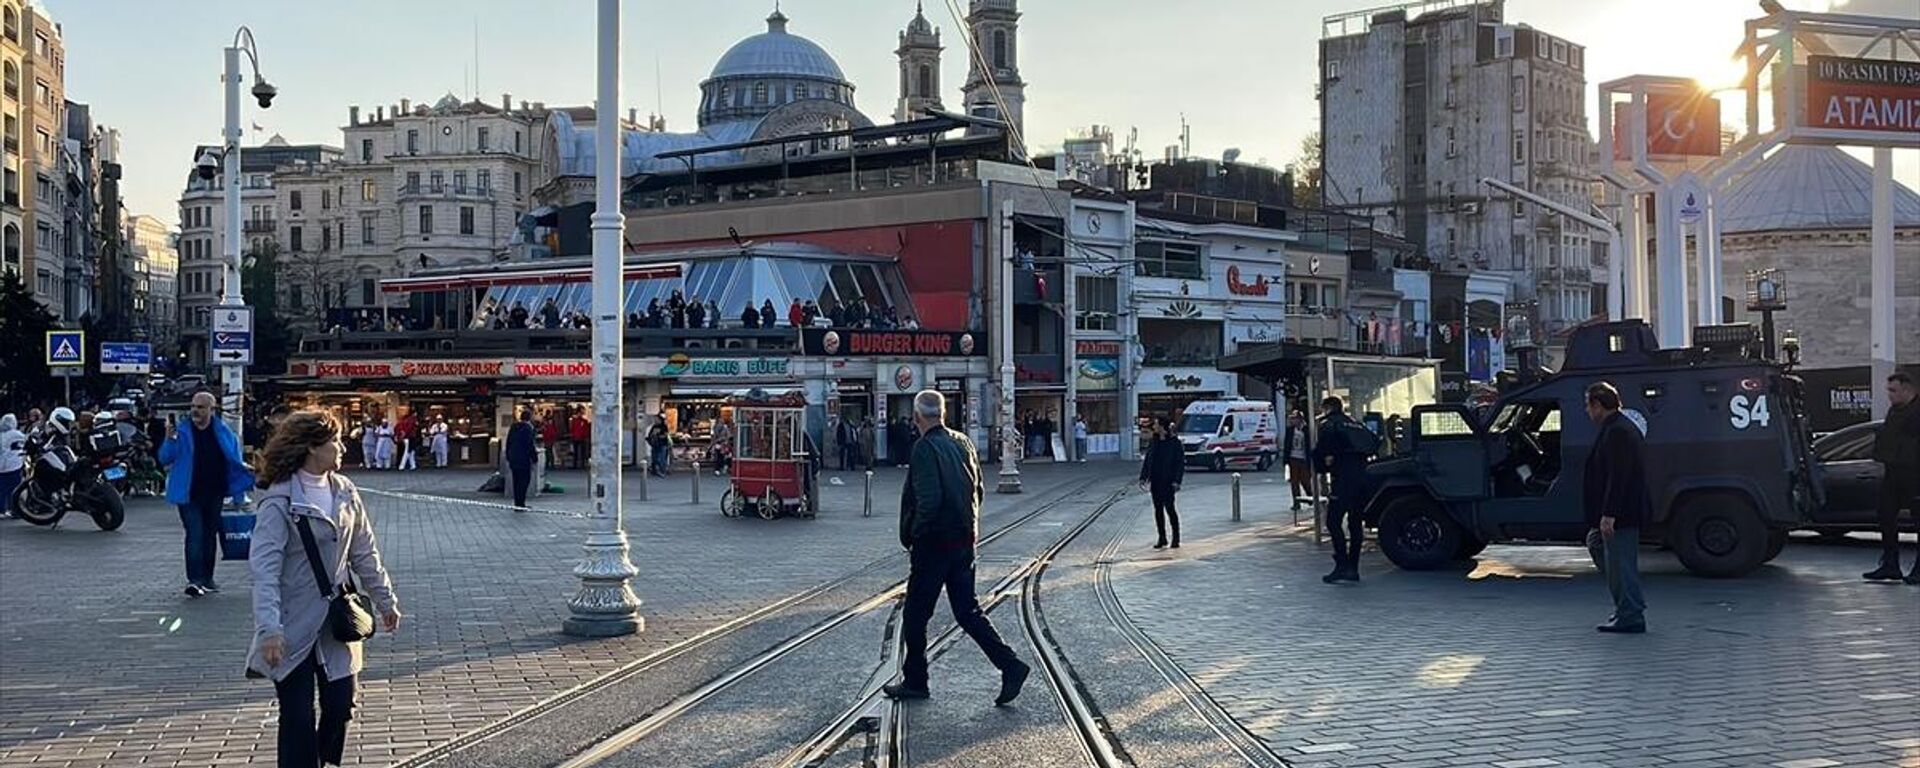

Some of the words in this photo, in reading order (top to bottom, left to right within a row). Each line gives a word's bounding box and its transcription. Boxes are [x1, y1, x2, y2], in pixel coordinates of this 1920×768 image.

[1819, 62, 1834, 78] 10
[1838, 63, 1888, 82] KASIM
[851, 333, 912, 353] BURGER
[914, 334, 951, 354] KING
[514, 362, 565, 377] TAKSİM
[692, 360, 740, 375] BARIŞ
[746, 356, 788, 375] BÜFE
[1729, 394, 1770, 429] S4
